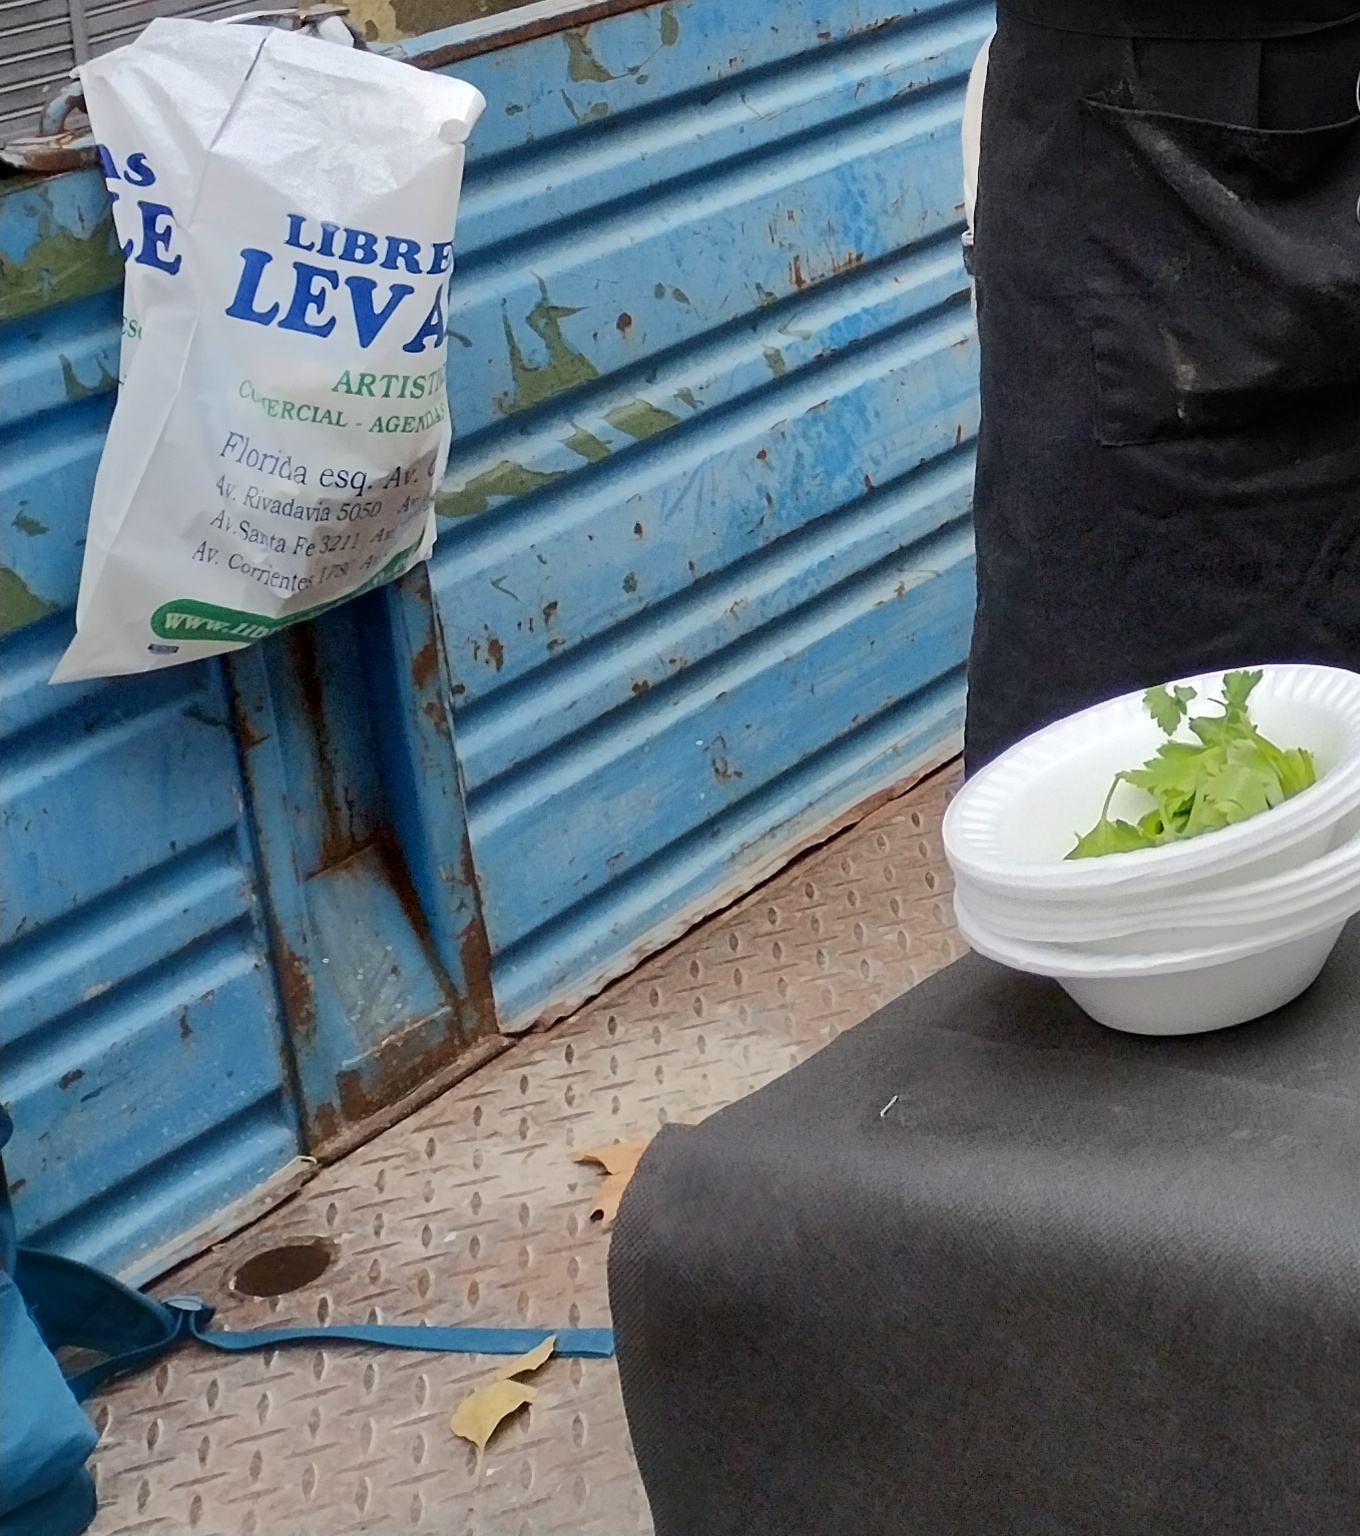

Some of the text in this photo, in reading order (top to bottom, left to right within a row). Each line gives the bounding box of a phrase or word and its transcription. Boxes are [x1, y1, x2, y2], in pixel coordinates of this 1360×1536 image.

[284, 213, 453, 275] LIBRE
[225, 247, 444, 354] LEVA
[239, 379, 349, 427] CERCIAL
[219, 431, 307, 486] Florida
[319, 467, 373, 497] esq.
[243, 484, 330, 522] Rivadavia
[192, 540, 219, 565] Av.
[238, 520, 286, 554] Santa
[292, 535, 316, 558] Fe
